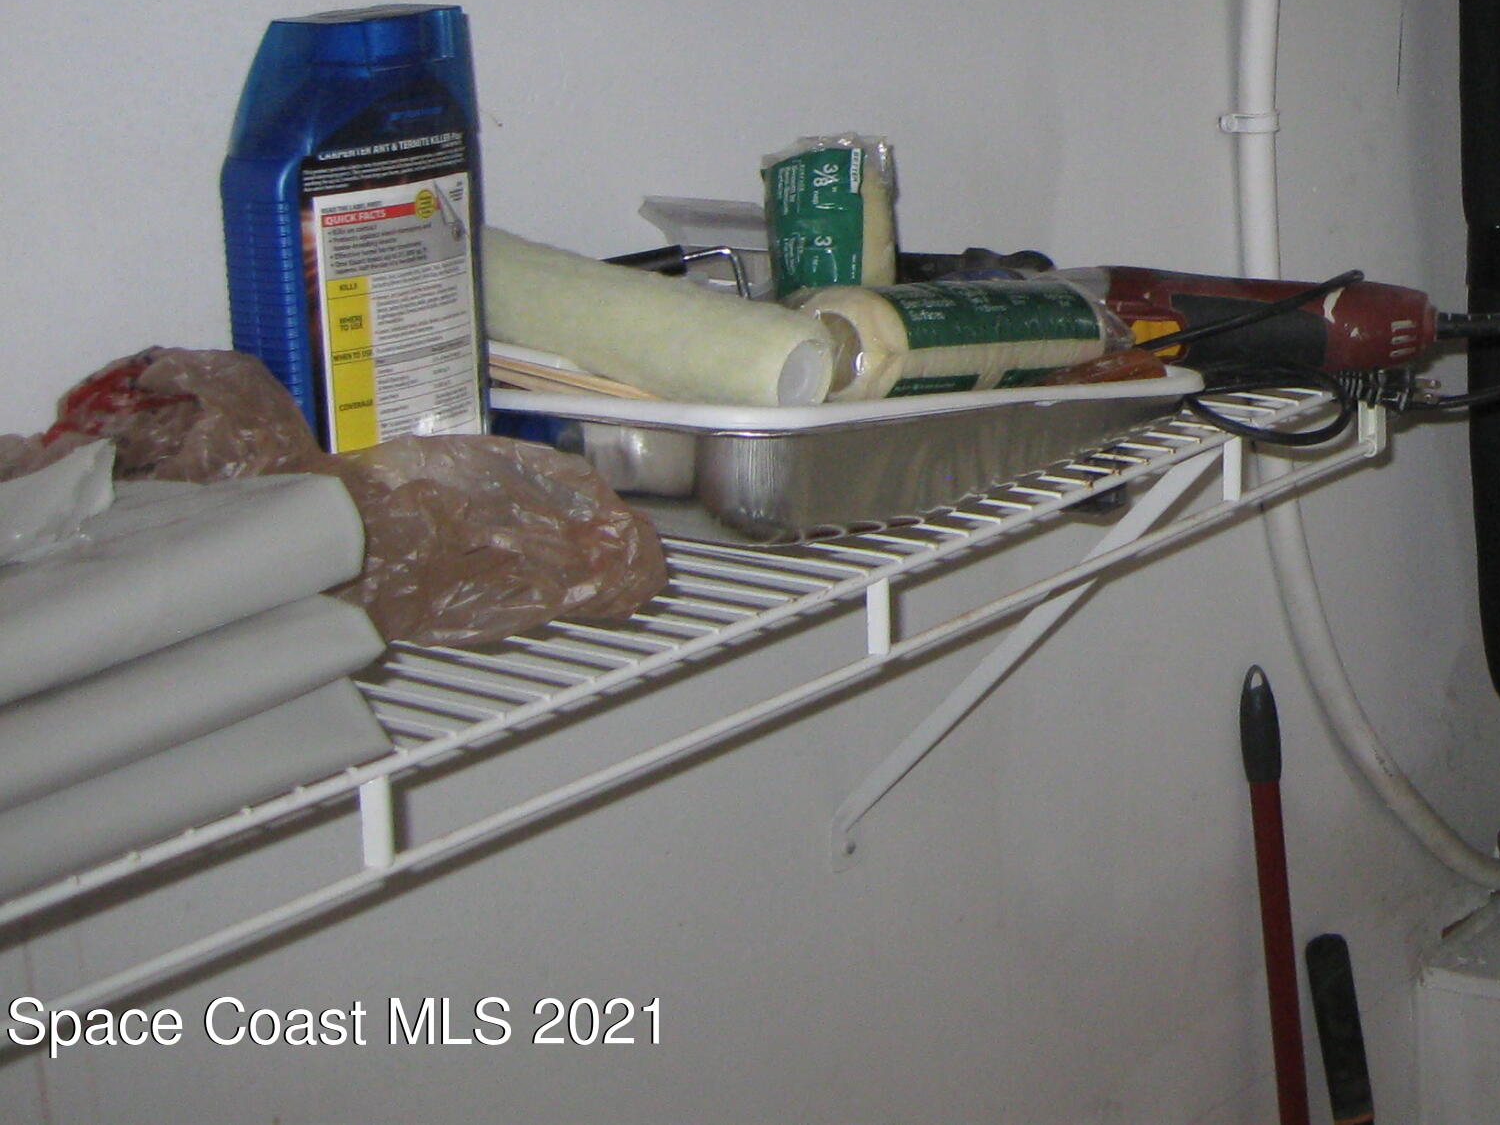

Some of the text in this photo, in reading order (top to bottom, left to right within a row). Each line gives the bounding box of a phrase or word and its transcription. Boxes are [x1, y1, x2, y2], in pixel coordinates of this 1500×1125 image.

[318, 147, 372, 161] CARPENTER
[373, 143, 391, 155] ANT
[391, 141, 398, 152] &
[399, 138, 430, 150] TERMITE
[324, 208, 387, 226] QUICK FACTS
[339, 282, 357, 292] KILLS
[339, 314, 363, 324] WHERE
[340, 321, 364, 331] TO USE
[333, 348, 372, 362] WHEN TO USE
[338, 398, 373, 412] COVERAGE
